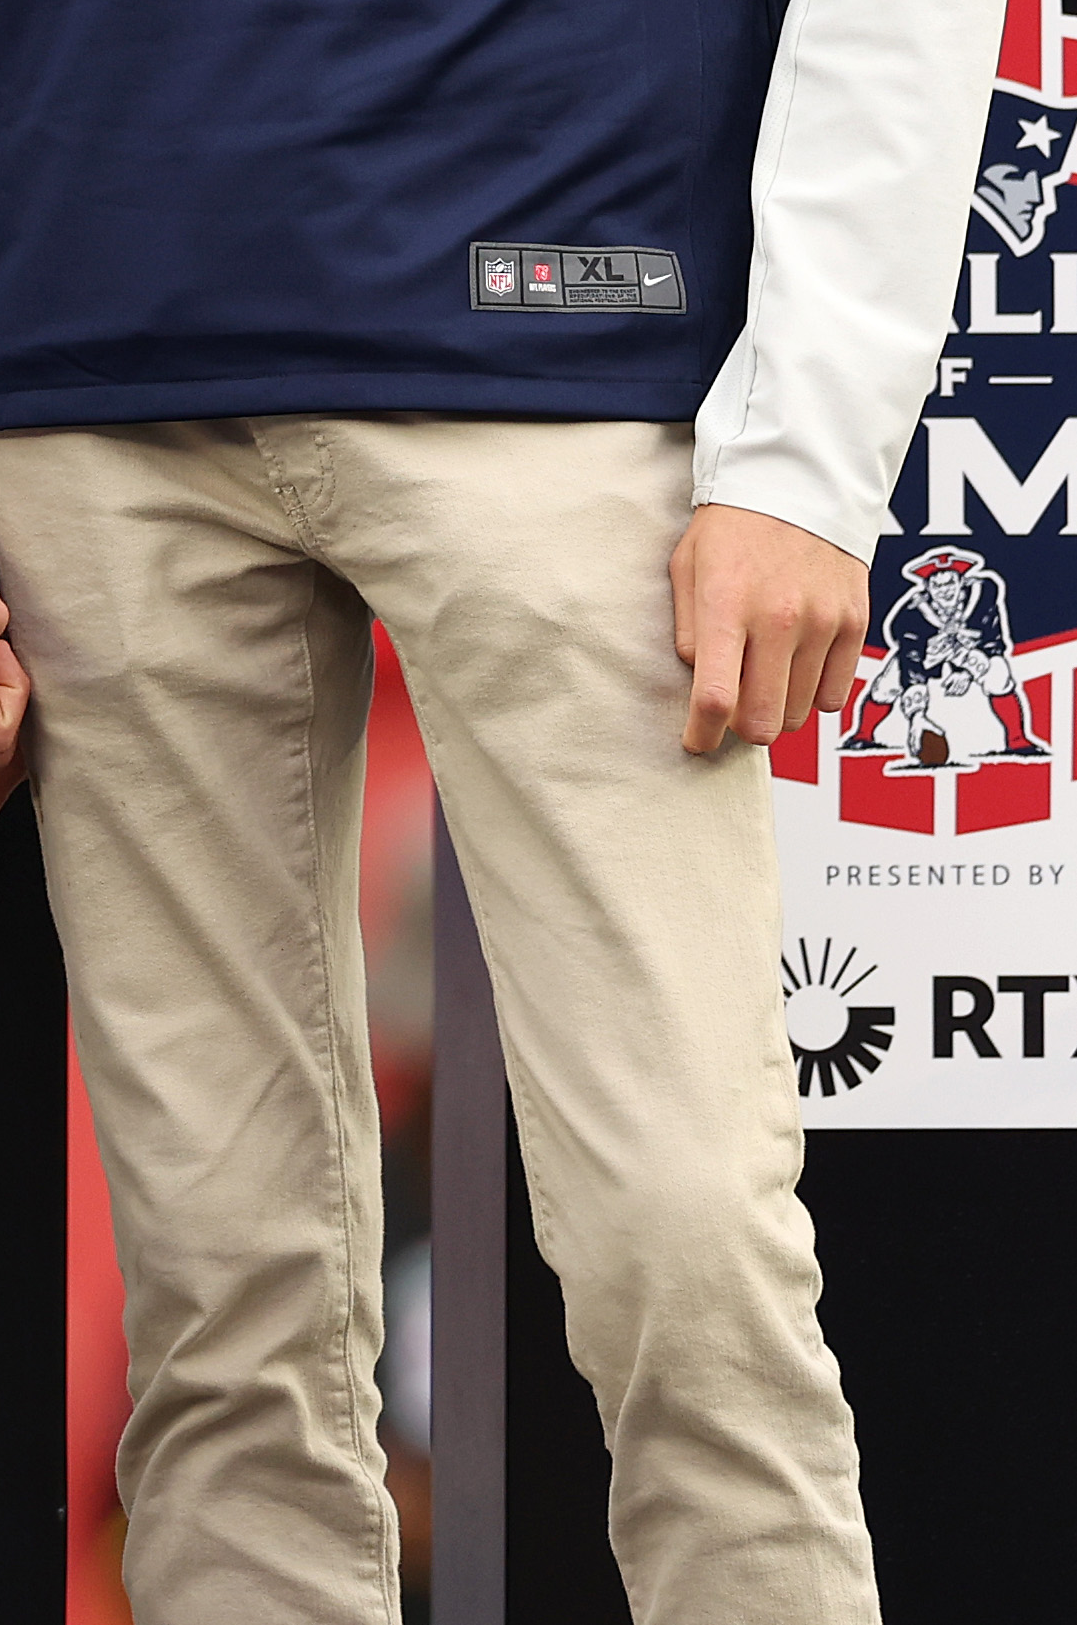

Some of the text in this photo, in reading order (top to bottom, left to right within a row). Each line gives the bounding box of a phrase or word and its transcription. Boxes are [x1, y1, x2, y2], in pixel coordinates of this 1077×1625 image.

[489, 274, 512, 290] NFL
[577, 256, 624, 281] XL
[925, 357, 973, 397] F
[880, 417, 1077, 535] M
[826, 864, 1065, 886] PRESENTED BY
[932, 975, 1077, 1059] RT
